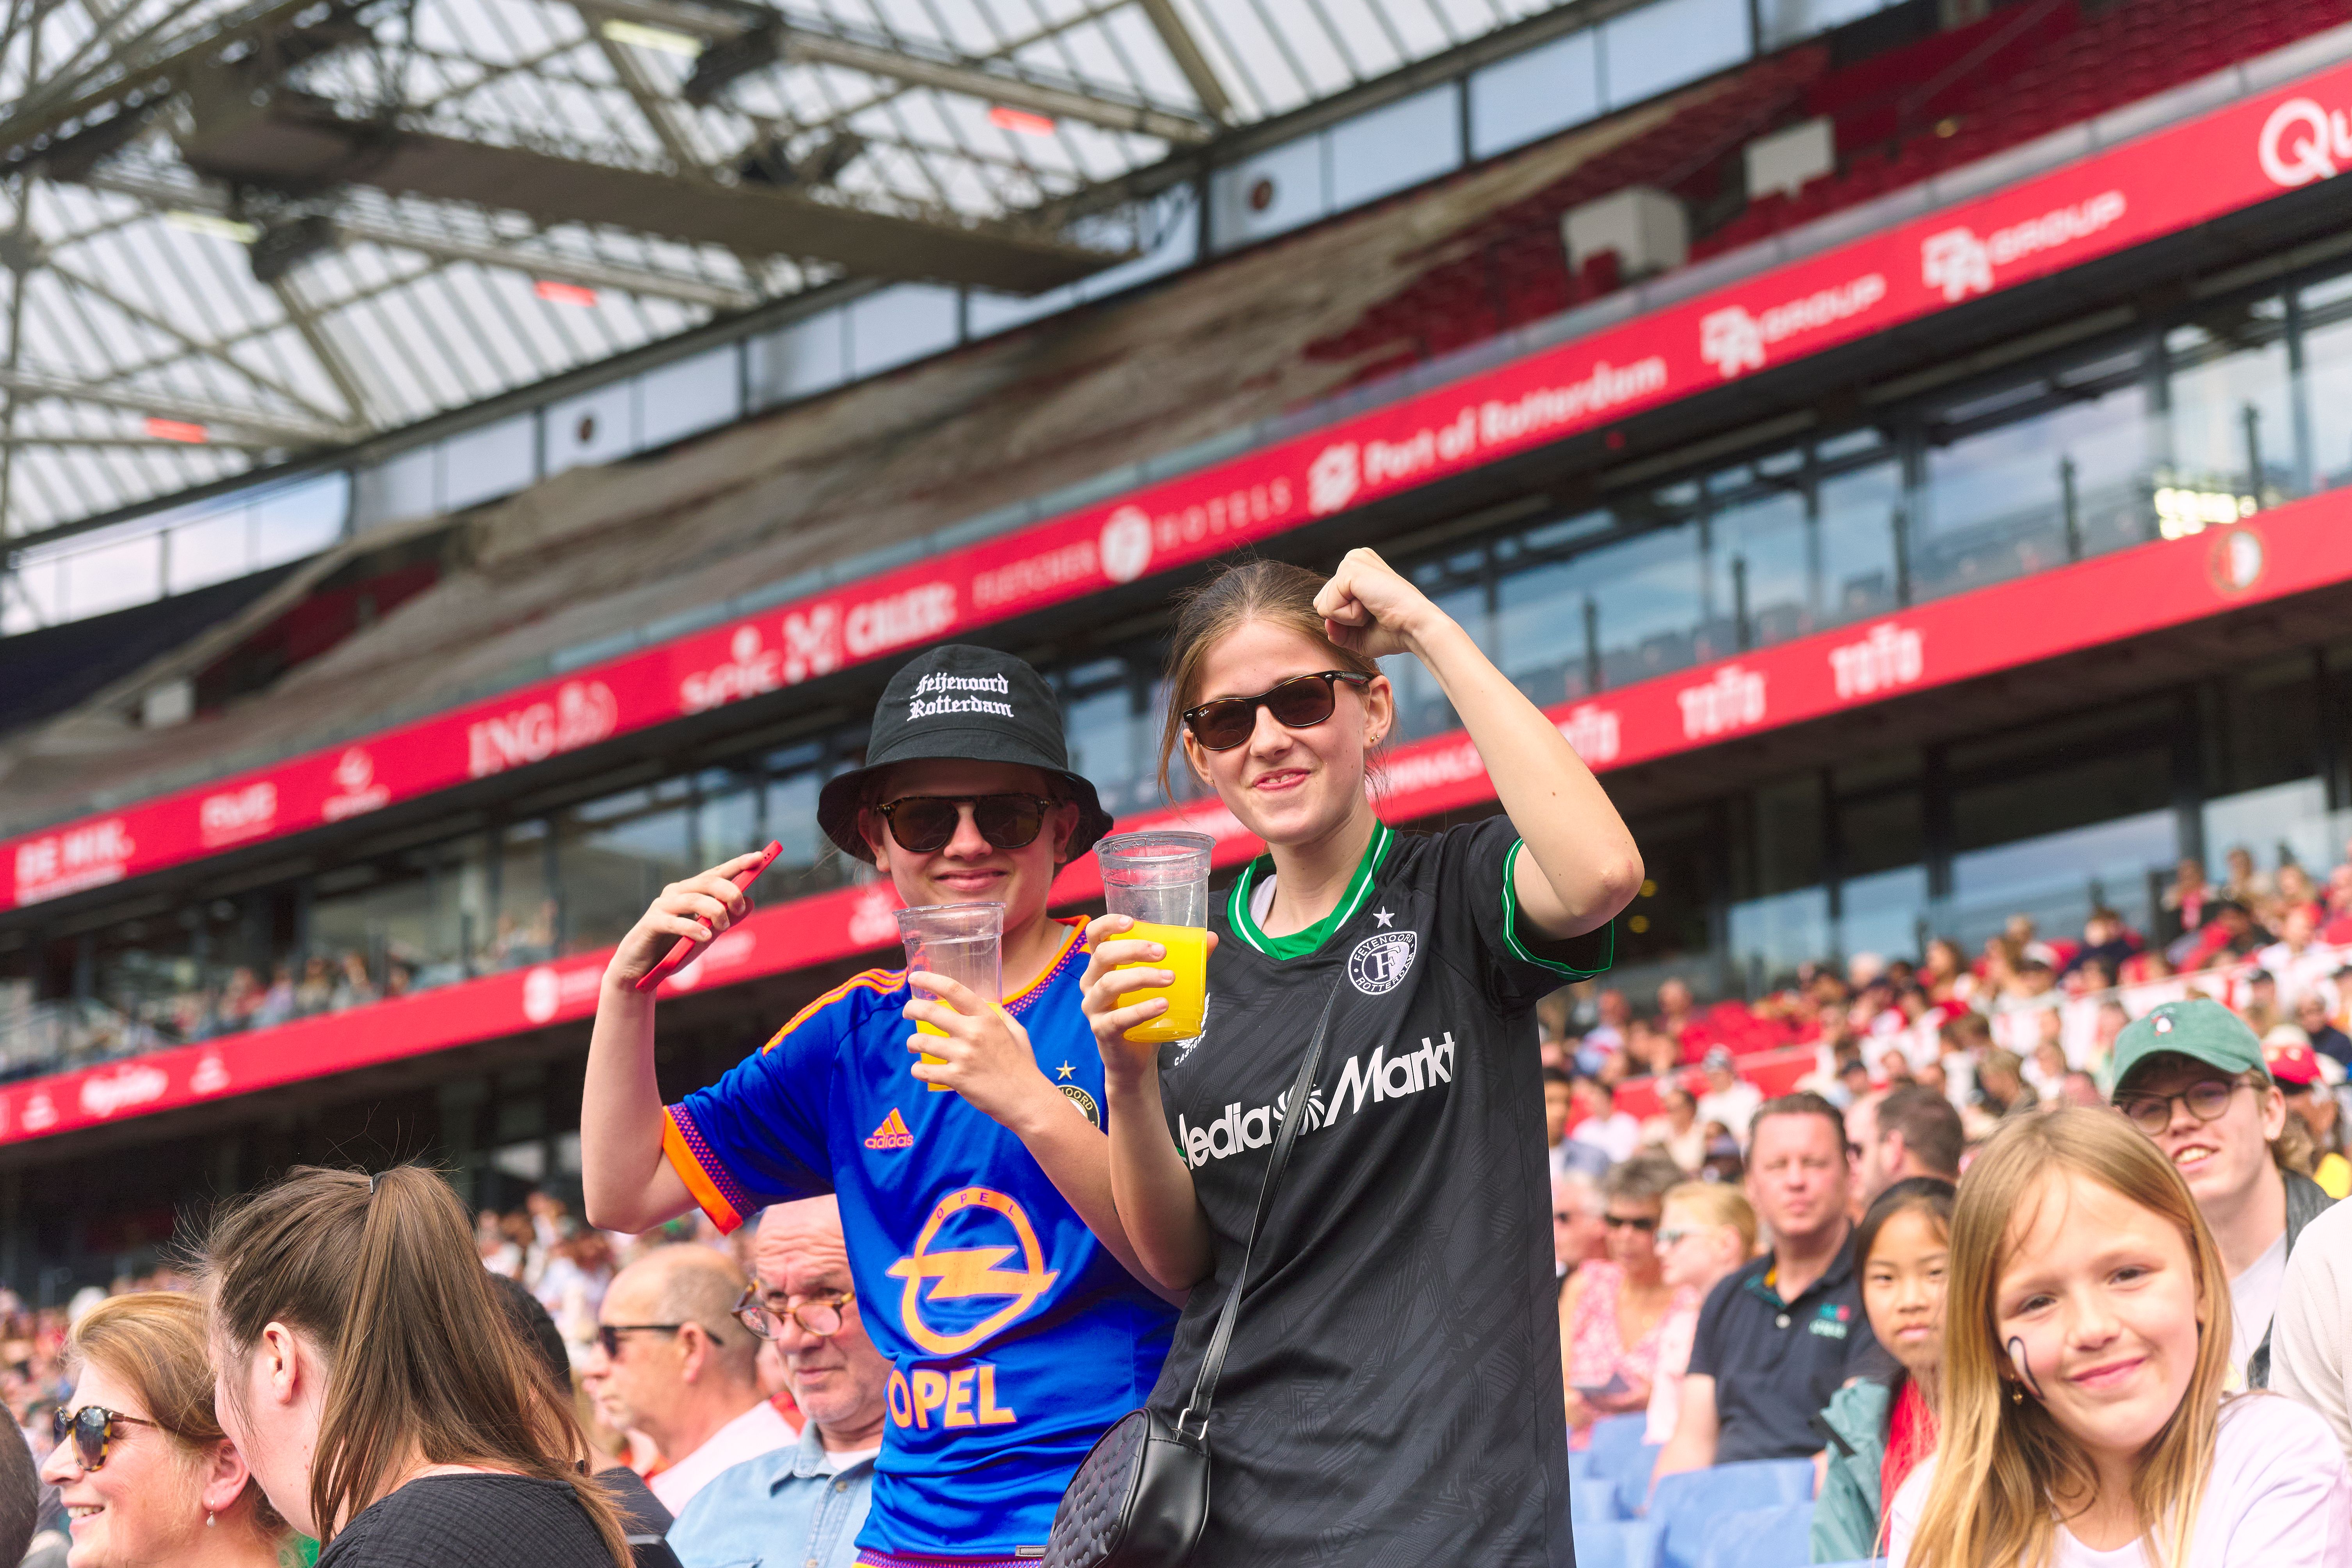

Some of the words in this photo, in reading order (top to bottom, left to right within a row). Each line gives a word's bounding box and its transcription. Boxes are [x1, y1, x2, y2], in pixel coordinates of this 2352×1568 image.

[1988, 189, 2126, 265] GROUP
[1757, 272, 1887, 344] GROUP
[1363, 429, 1435, 484] Port
[1437, 406, 1476, 460] of
[1480, 356, 1668, 445] Rotterdam
[1155, 477, 1293, 550] HOTELS
[910, 672, 1009, 699] Feijenoord
[907, 695, 1014, 722] Rotterdam
[470, 703, 555, 780] ING
[1354, 934, 1414, 962] FEYENOORD
[1355, 952, 1414, 992] ROTTERDAM
[1174, 1029, 1207, 1066] CASTORE
[1062, 1087, 1093, 1111] OORD
[1323, 1031, 1455, 1128] Markt
[865, 1134, 914, 1150] adidas
[936, 1192, 1016, 1219] OPEL
[887, 1365, 1017, 1429] OPEL
